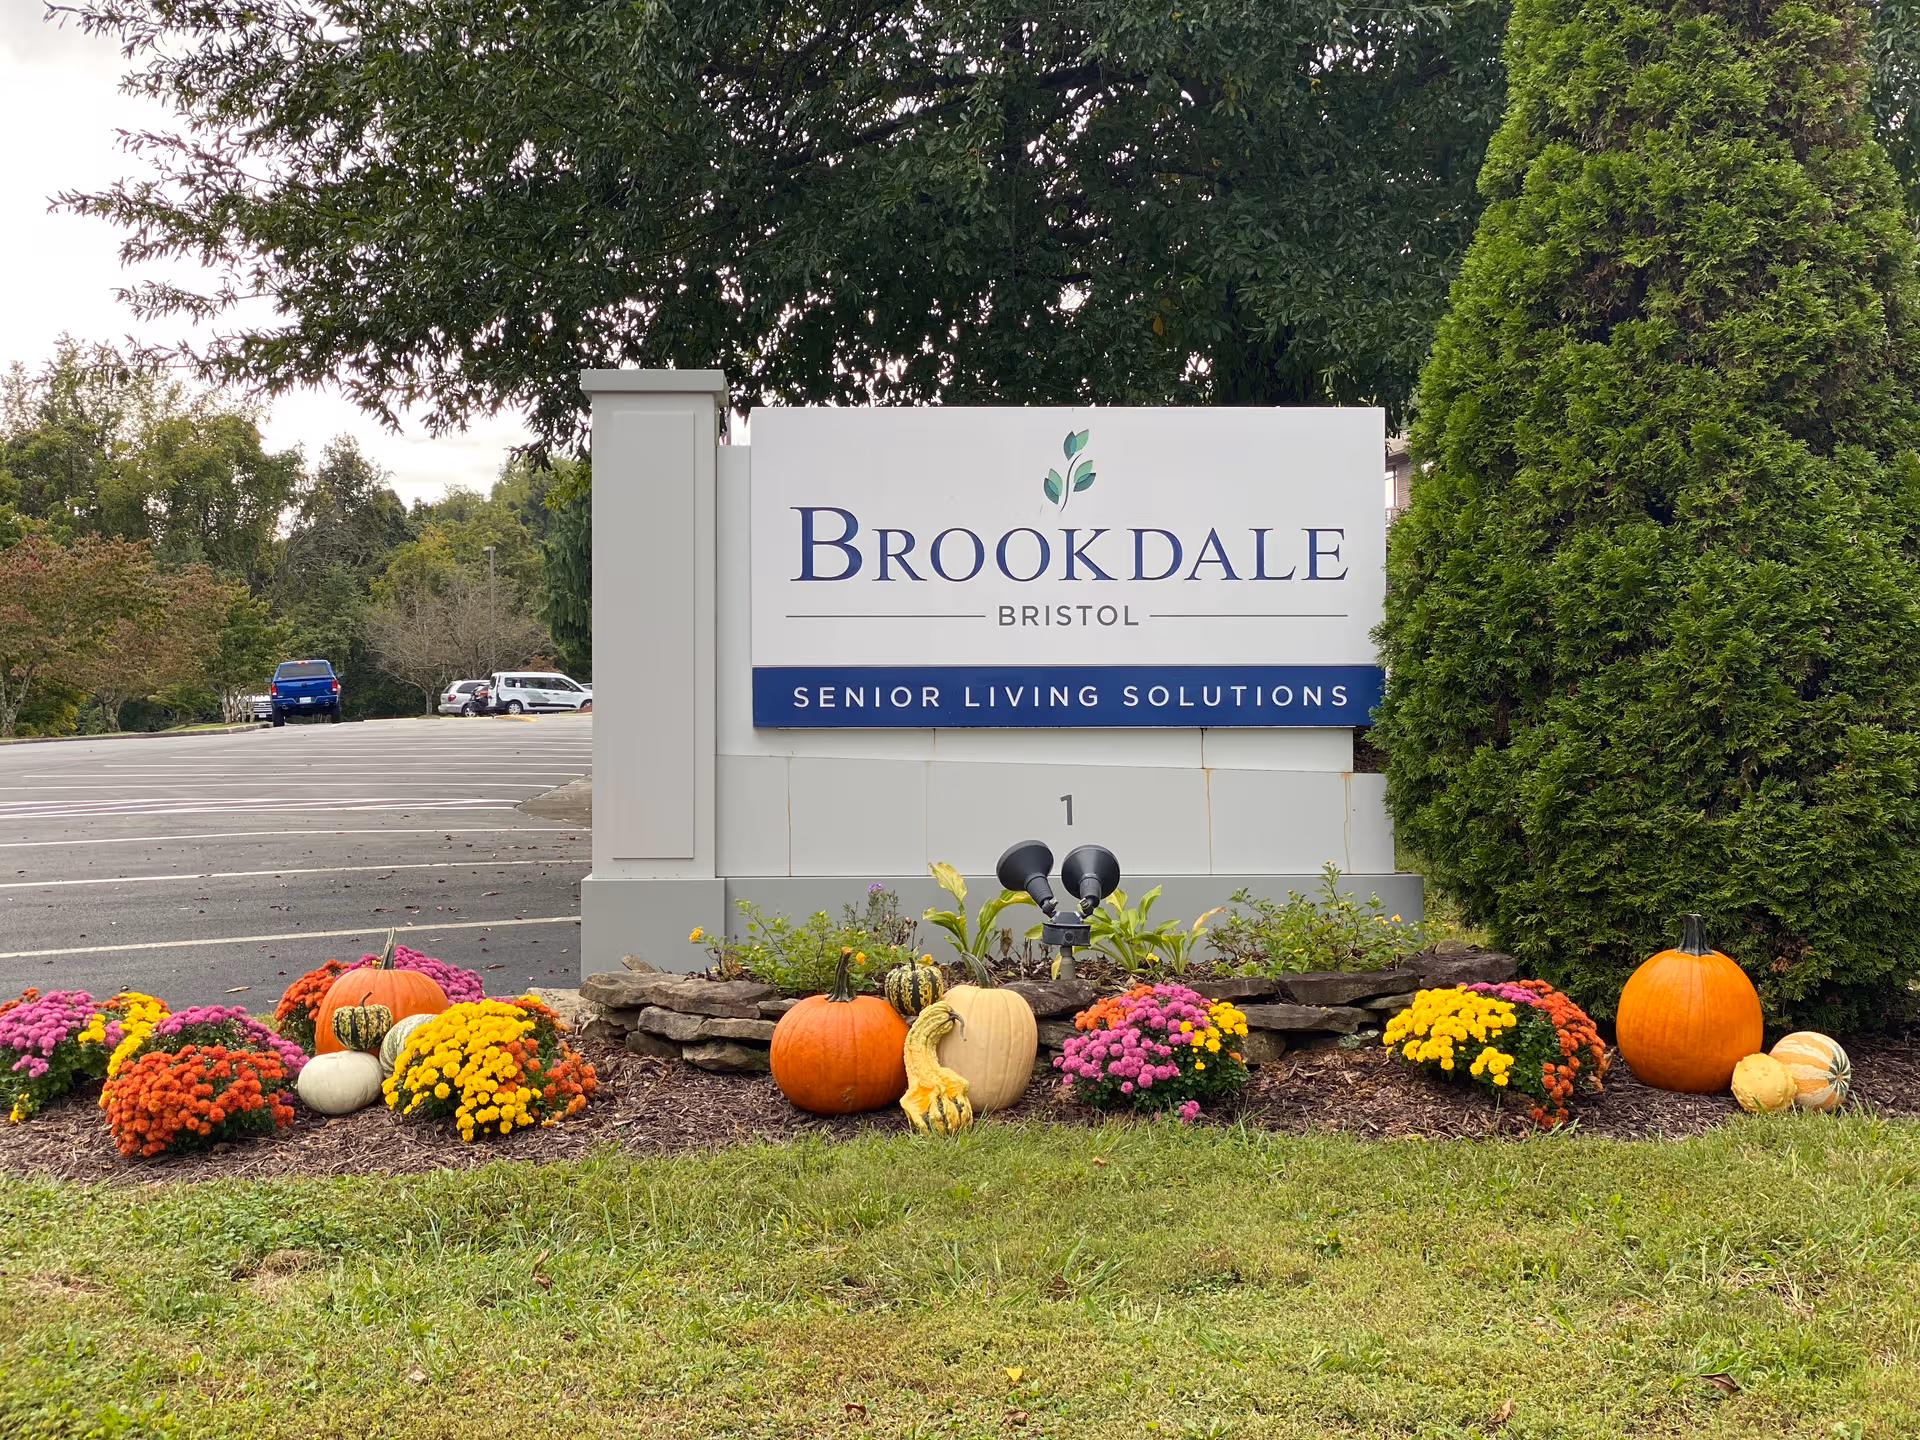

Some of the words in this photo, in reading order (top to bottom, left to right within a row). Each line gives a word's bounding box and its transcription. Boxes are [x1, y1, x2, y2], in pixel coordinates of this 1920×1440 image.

[790, 507, 1348, 582] BROOKDALE
[998, 605, 1139, 626] BRISTOL
[793, 686, 940, 708] SENIOR
[965, 685, 1098, 707] LIVING
[1123, 685, 1348, 707] SOLUTIONS
[1060, 795, 1073, 825] 1
